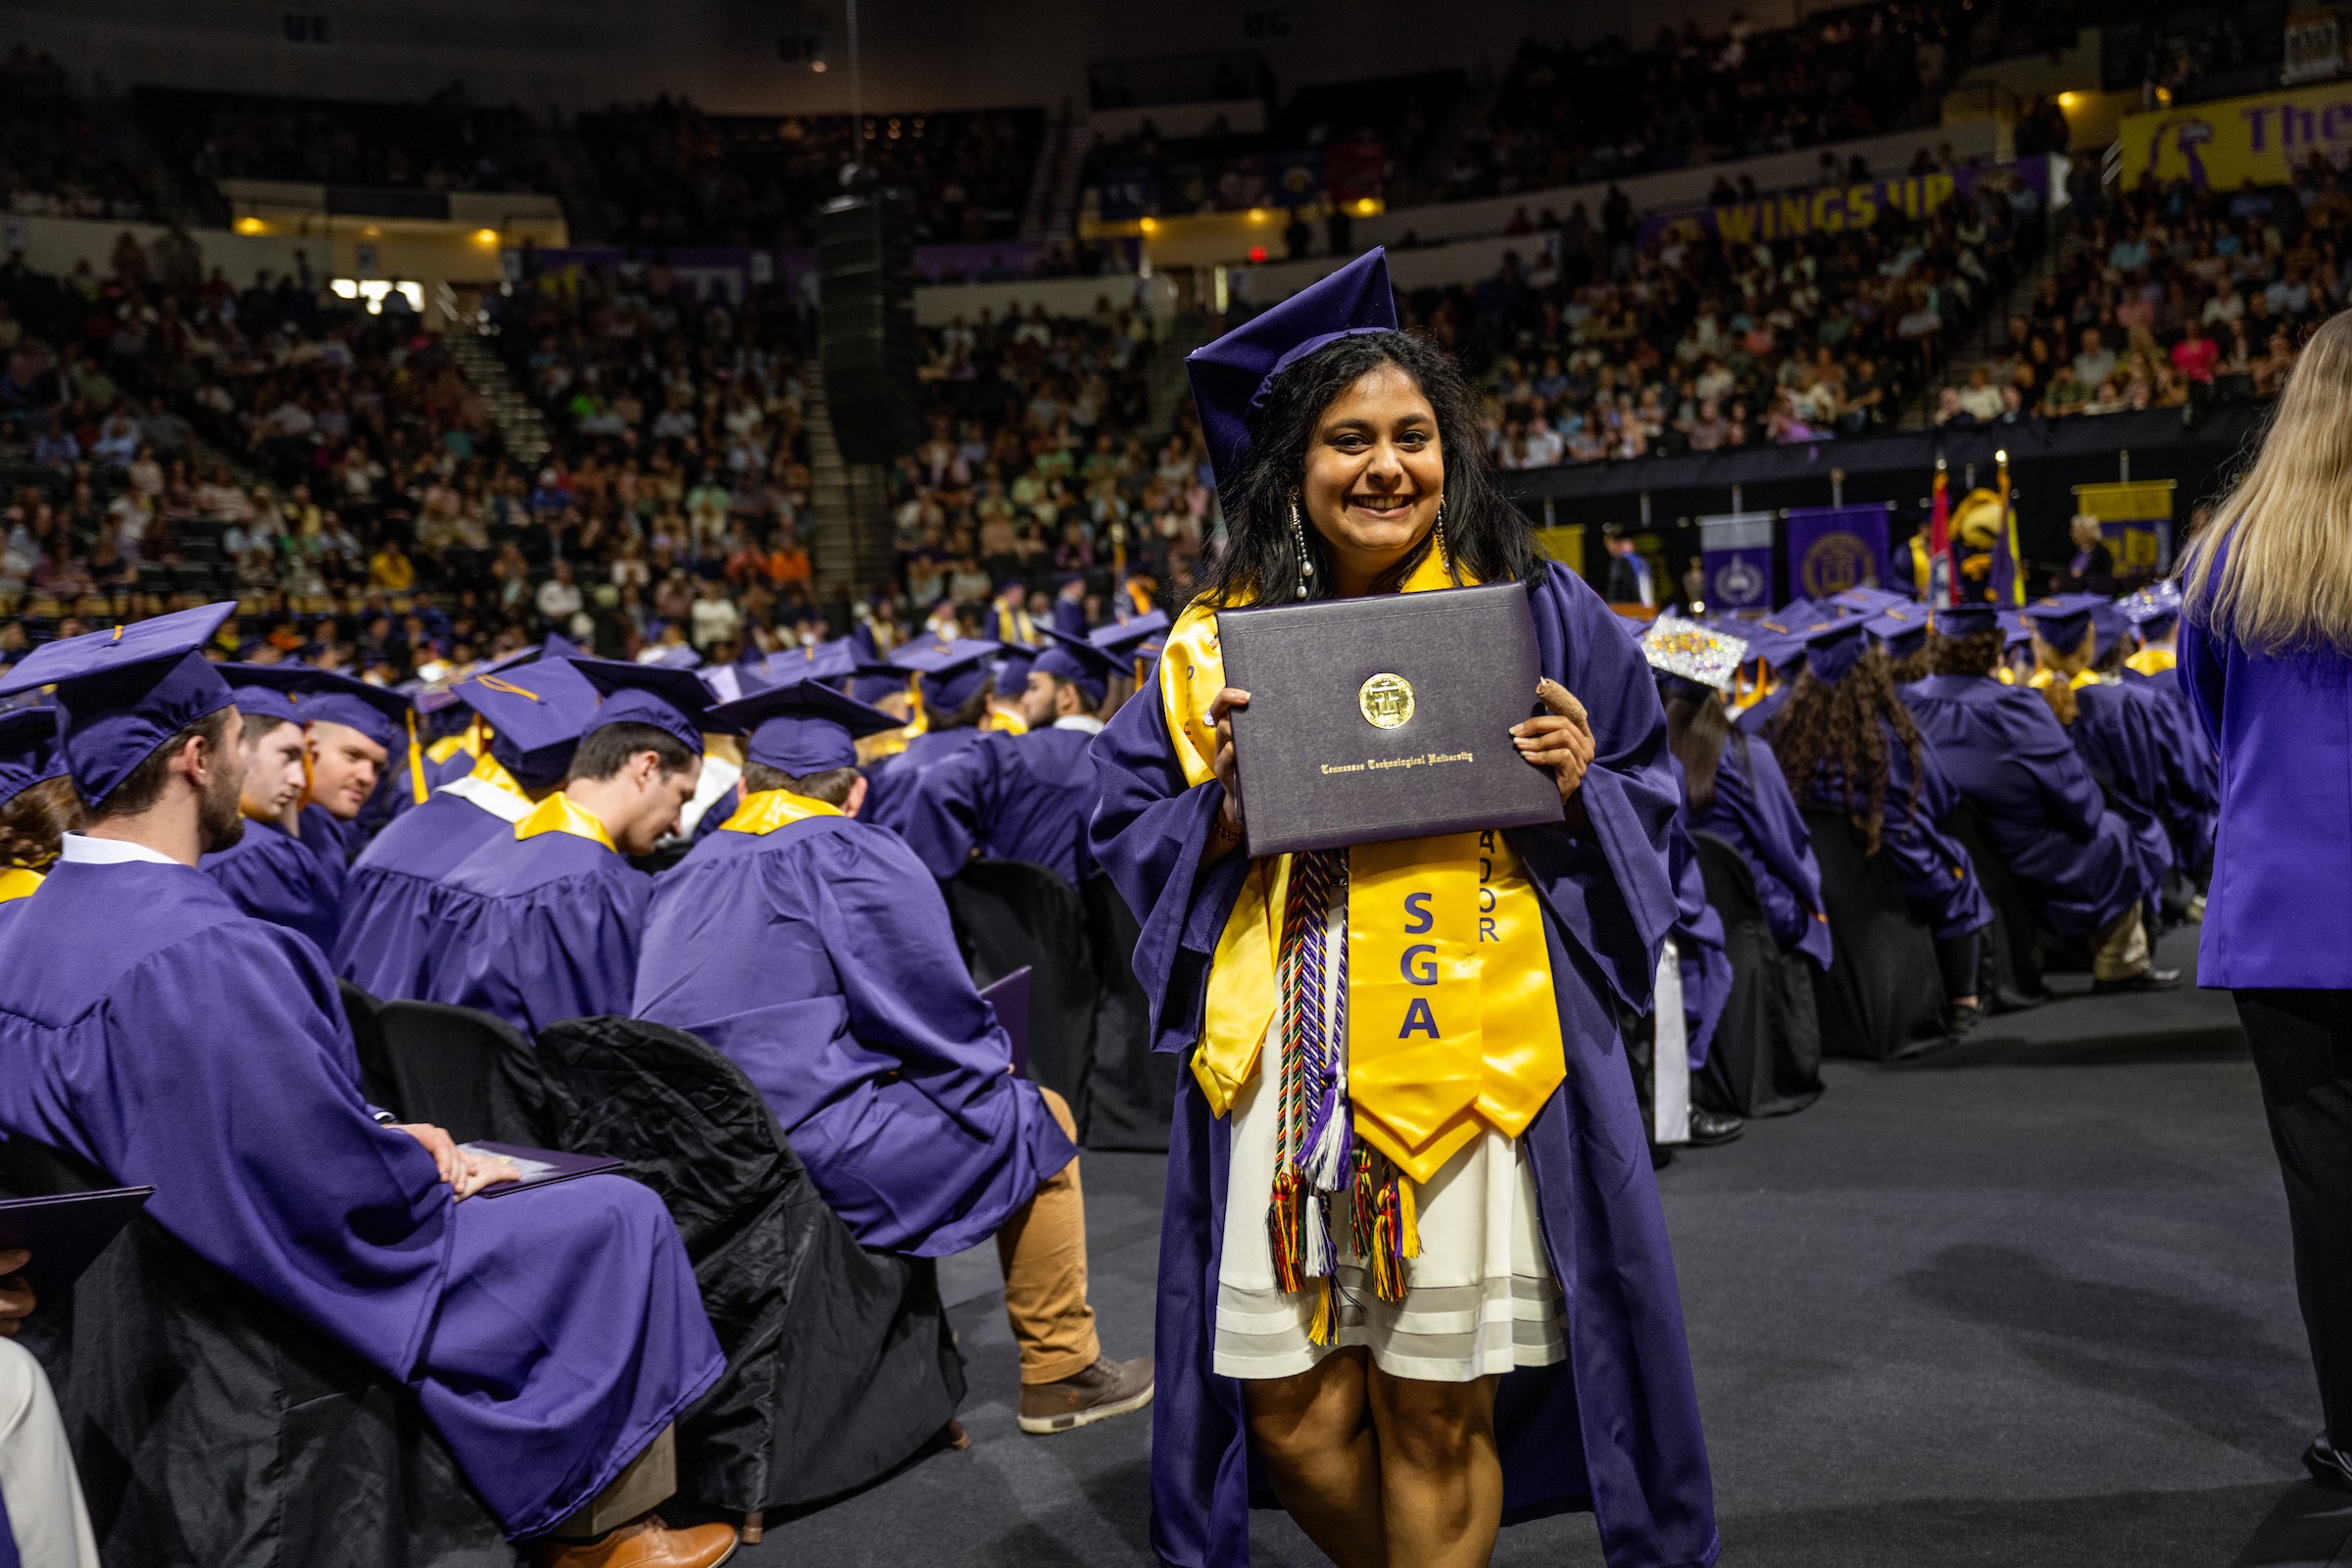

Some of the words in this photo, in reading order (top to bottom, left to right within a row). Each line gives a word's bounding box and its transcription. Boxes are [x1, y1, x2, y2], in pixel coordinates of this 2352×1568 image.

[2242, 102, 2352, 152] The
[1715, 183, 1878, 243] WINGS
[1320, 763, 1365, 774] Tennessee
[1367, 755, 1426, 769] Technological
[1428, 752, 1473, 766] University
[1398, 892, 1441, 1039] SGA
